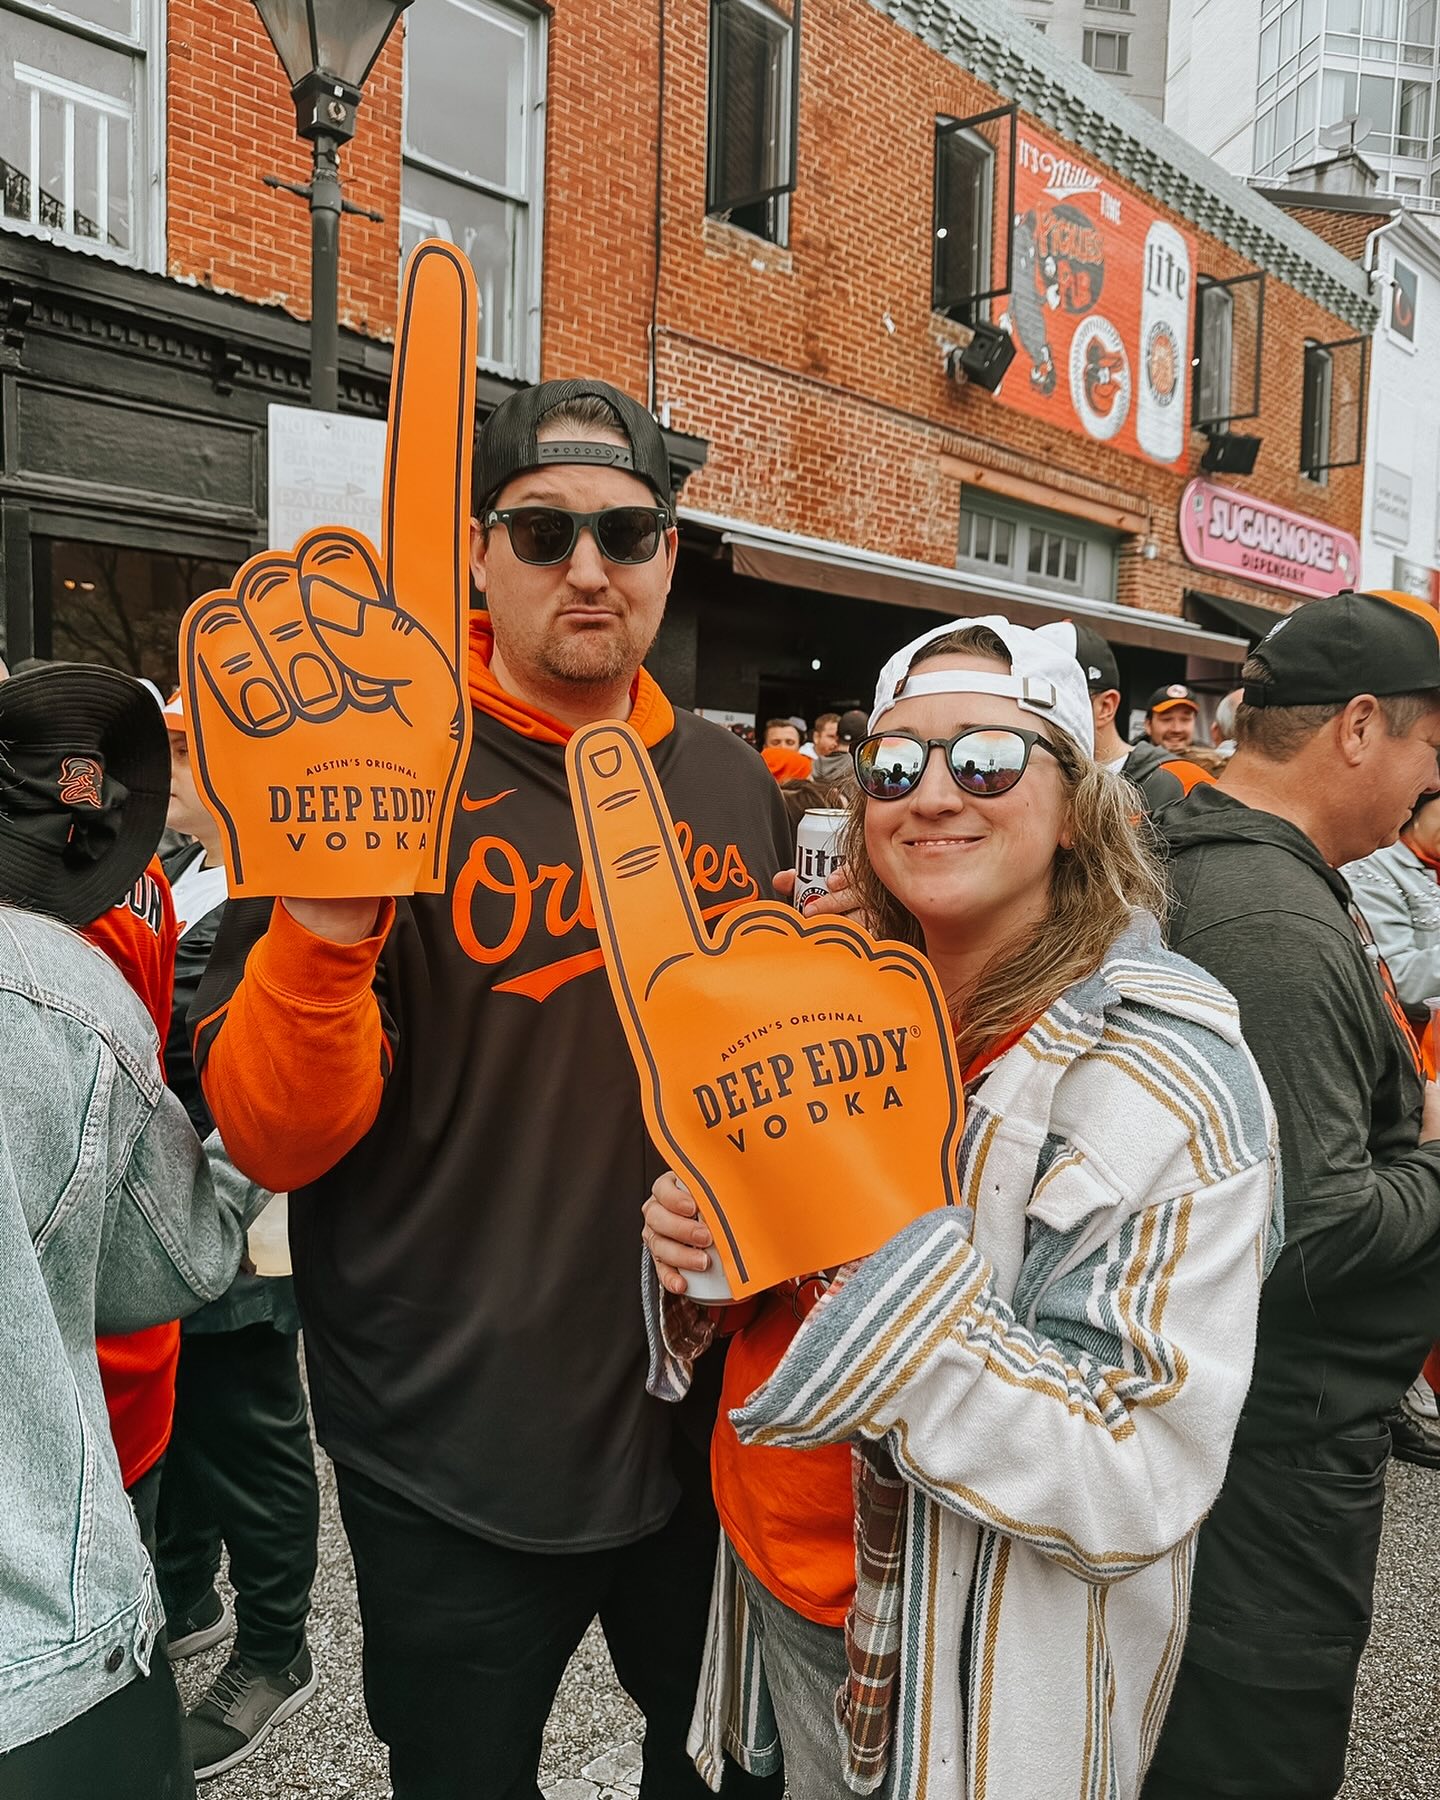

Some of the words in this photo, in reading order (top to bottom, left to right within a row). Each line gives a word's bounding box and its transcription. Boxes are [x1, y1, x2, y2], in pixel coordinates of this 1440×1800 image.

[1039, 152, 1104, 189] Miller
[1145, 244, 1187, 300] Lite
[280, 488, 380, 516] PARKING
[1209, 496, 1334, 573] SUGARMORE
[1241, 553, 1306, 582] DISPENSARY
[306, 758, 360, 776] AUSTIN'S
[365, 758, 418, 779] ORIGINAL
[268, 786, 363, 823] DEEP
[370, 786, 436, 823] EDDY
[286, 832, 426, 852] VODKA
[720, 1020, 783, 1062] AUSTIN'S
[790, 1012, 863, 1026] ORIGINAL
[693, 1053, 795, 1129] DEEP
[727, 1086, 903, 1153] VODKA
